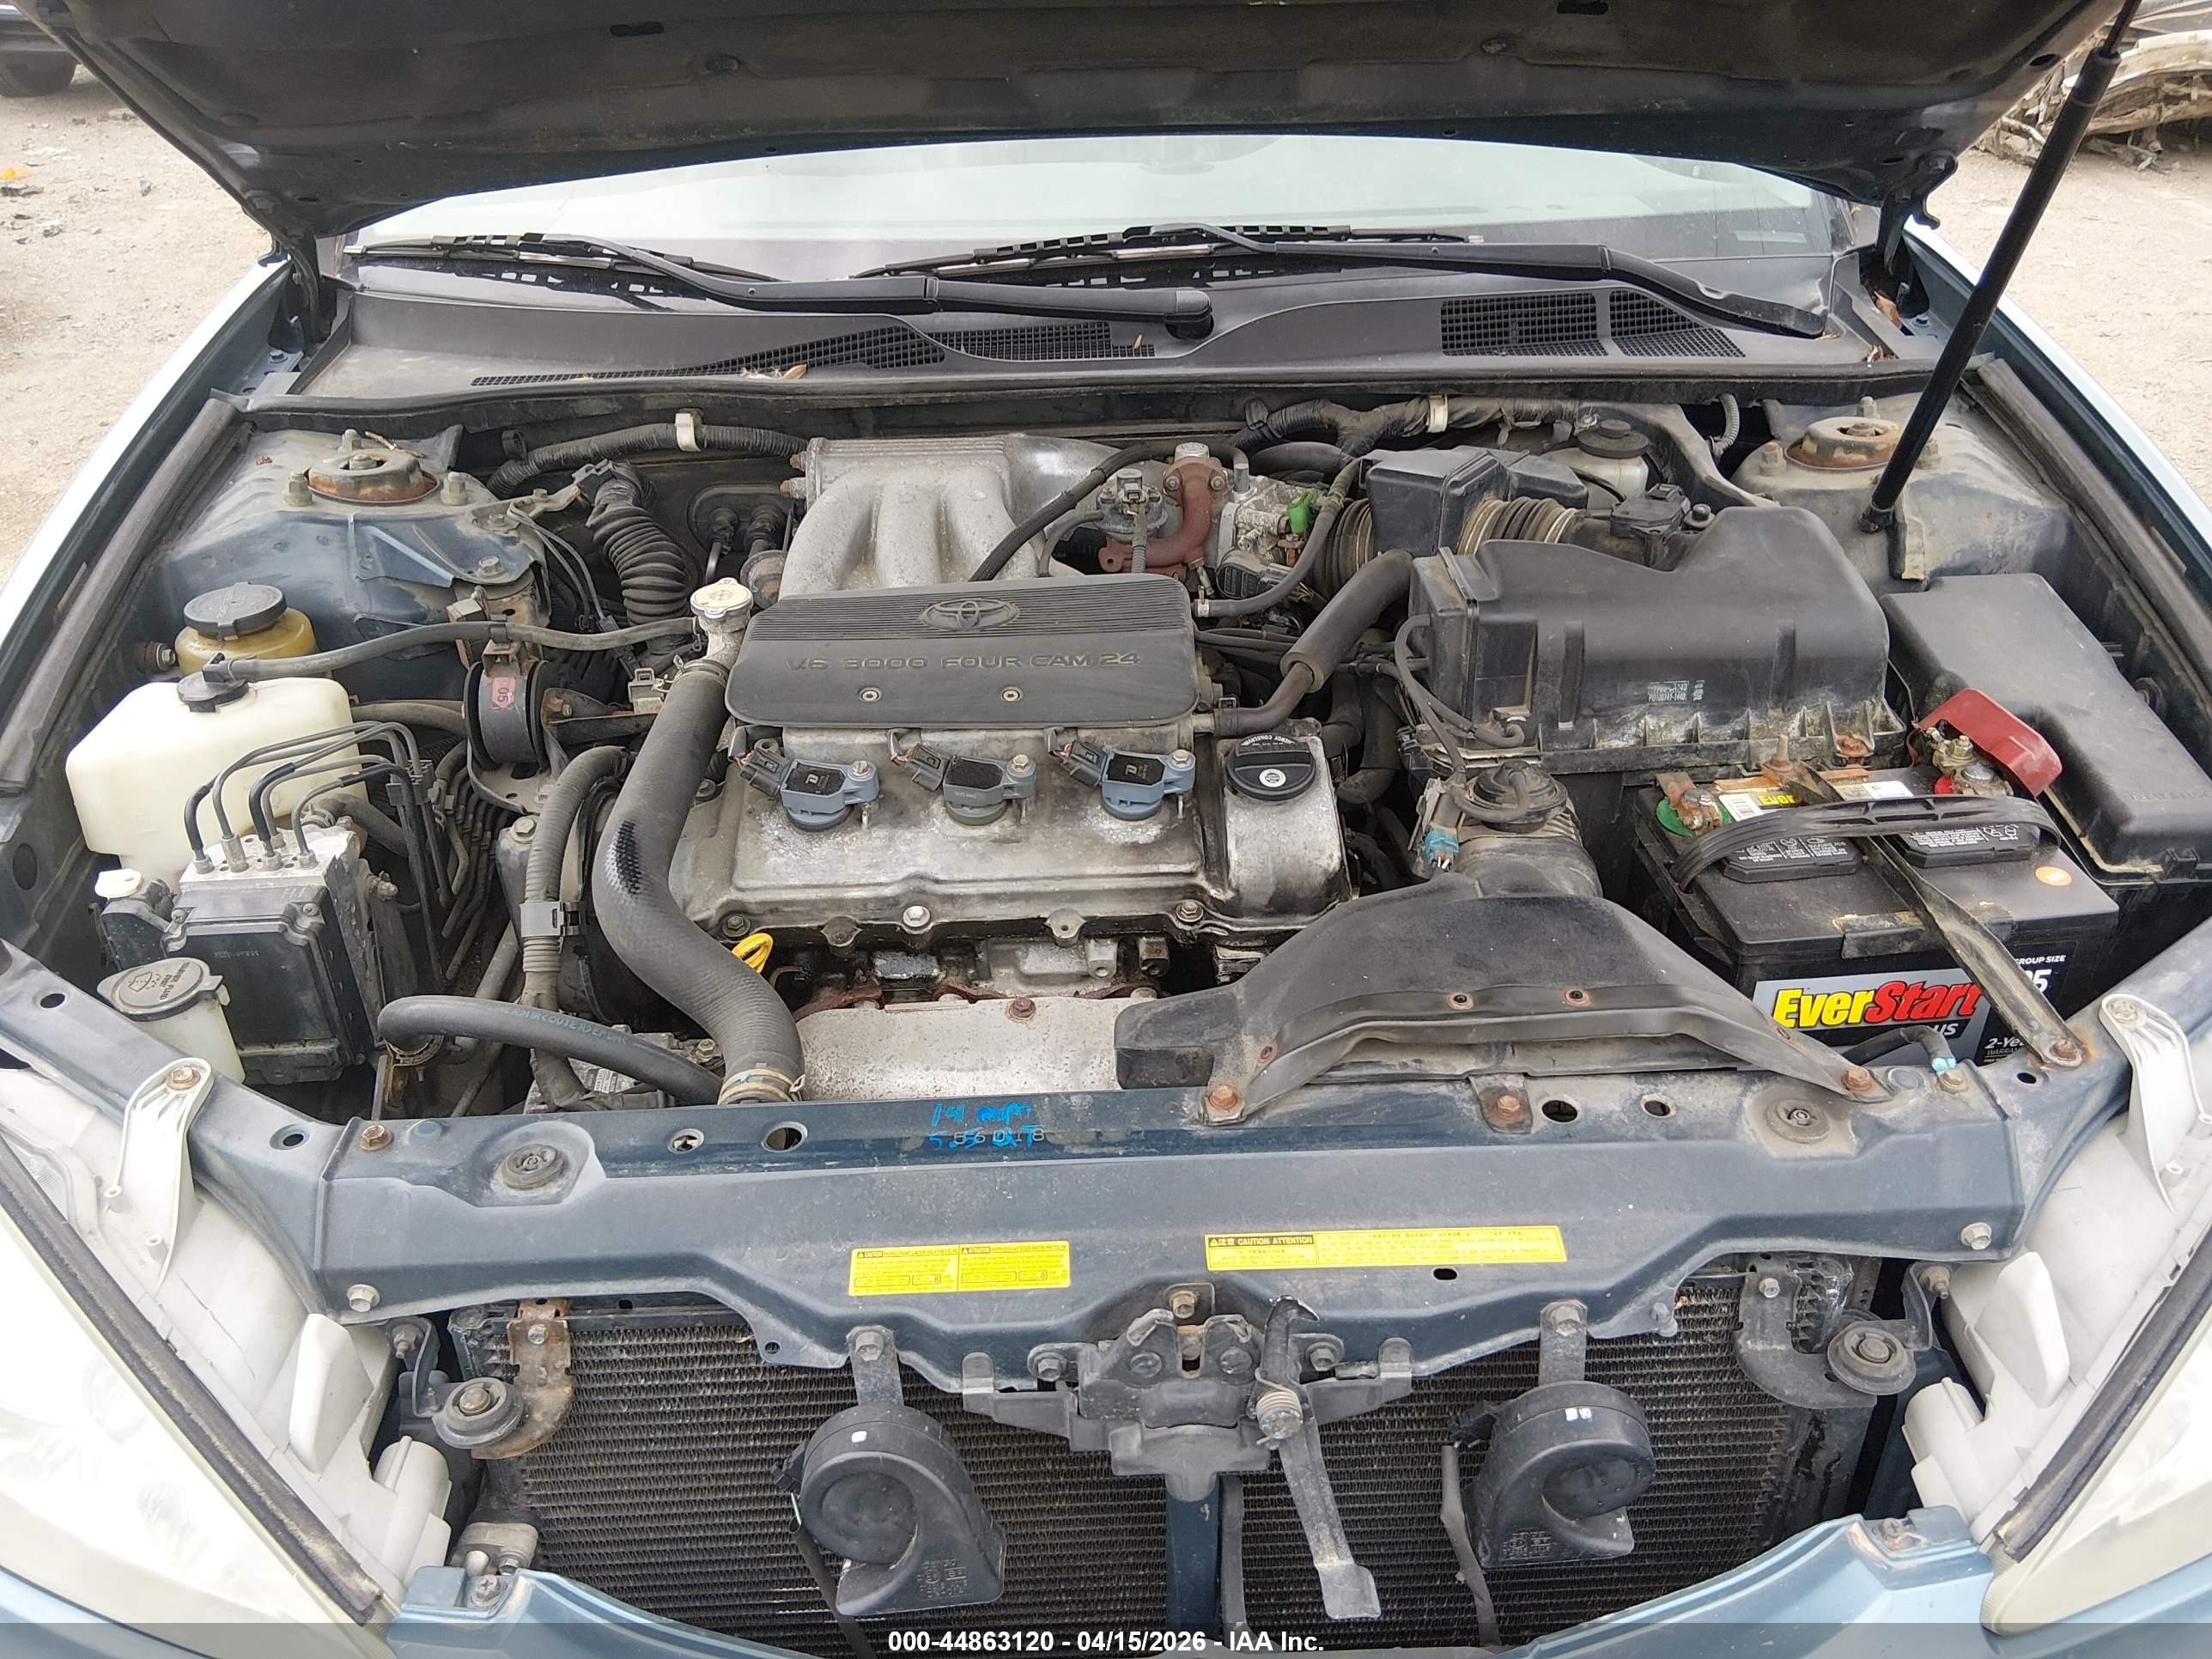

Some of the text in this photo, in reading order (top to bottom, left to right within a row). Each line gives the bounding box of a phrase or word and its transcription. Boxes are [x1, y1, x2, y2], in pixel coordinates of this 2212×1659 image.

[843, 656, 928, 670] 3000
[942, 654, 1024, 670] FOUR
[1030, 653, 1093, 668] CAM
[1098, 652, 1141, 666] 24
[2045, 954, 2067, 963] SIZE
[1771, 979, 1982, 1029] EverStart
[1237, 1237, 1270, 1246] CAUTION
[1273, 1235, 1313, 1244] ATTENTION
